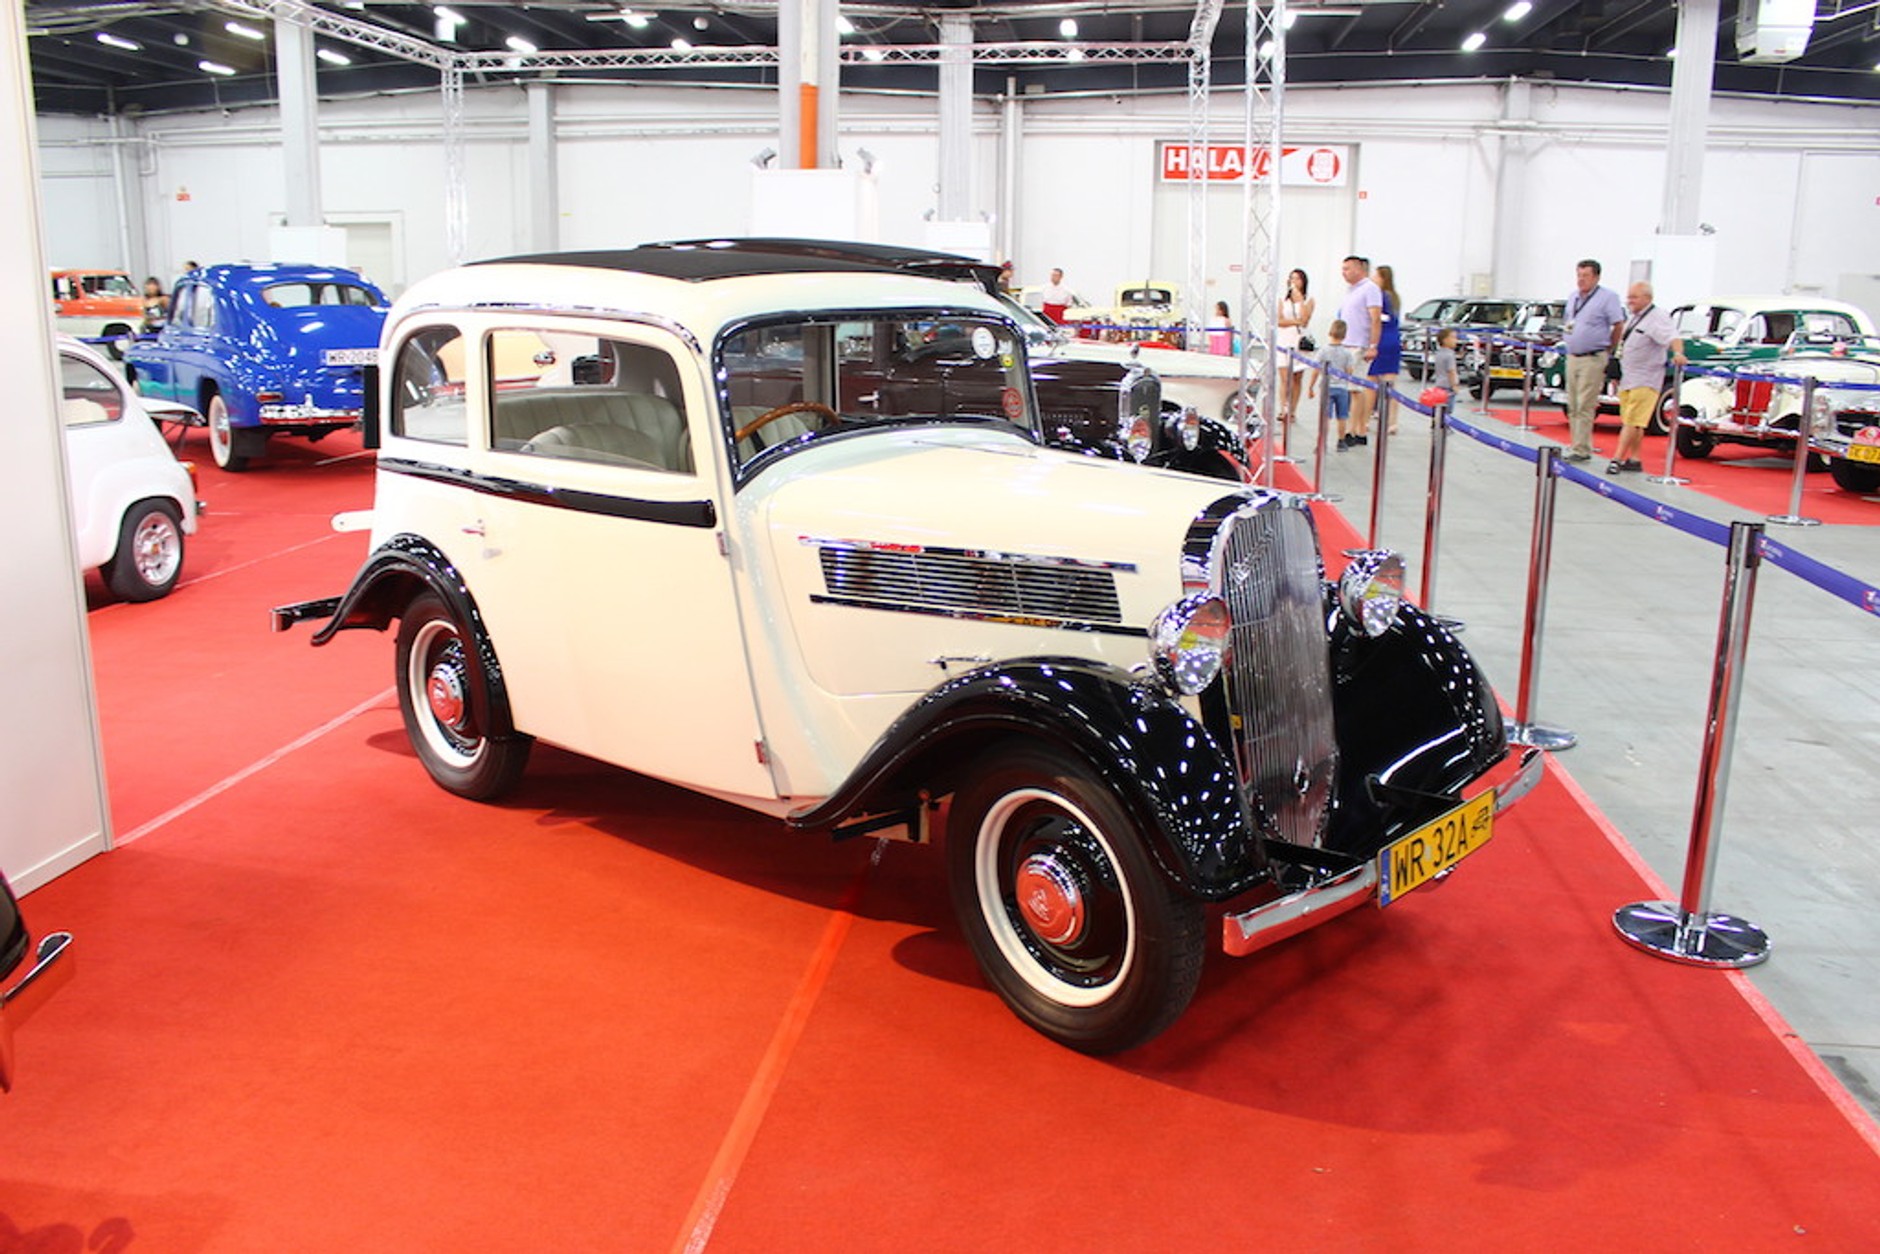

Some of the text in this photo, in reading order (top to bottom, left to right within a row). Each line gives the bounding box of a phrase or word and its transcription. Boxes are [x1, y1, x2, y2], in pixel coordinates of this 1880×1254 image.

[1167, 149, 1243, 172] HALA
[1395, 813, 1469, 891] WR 32A
